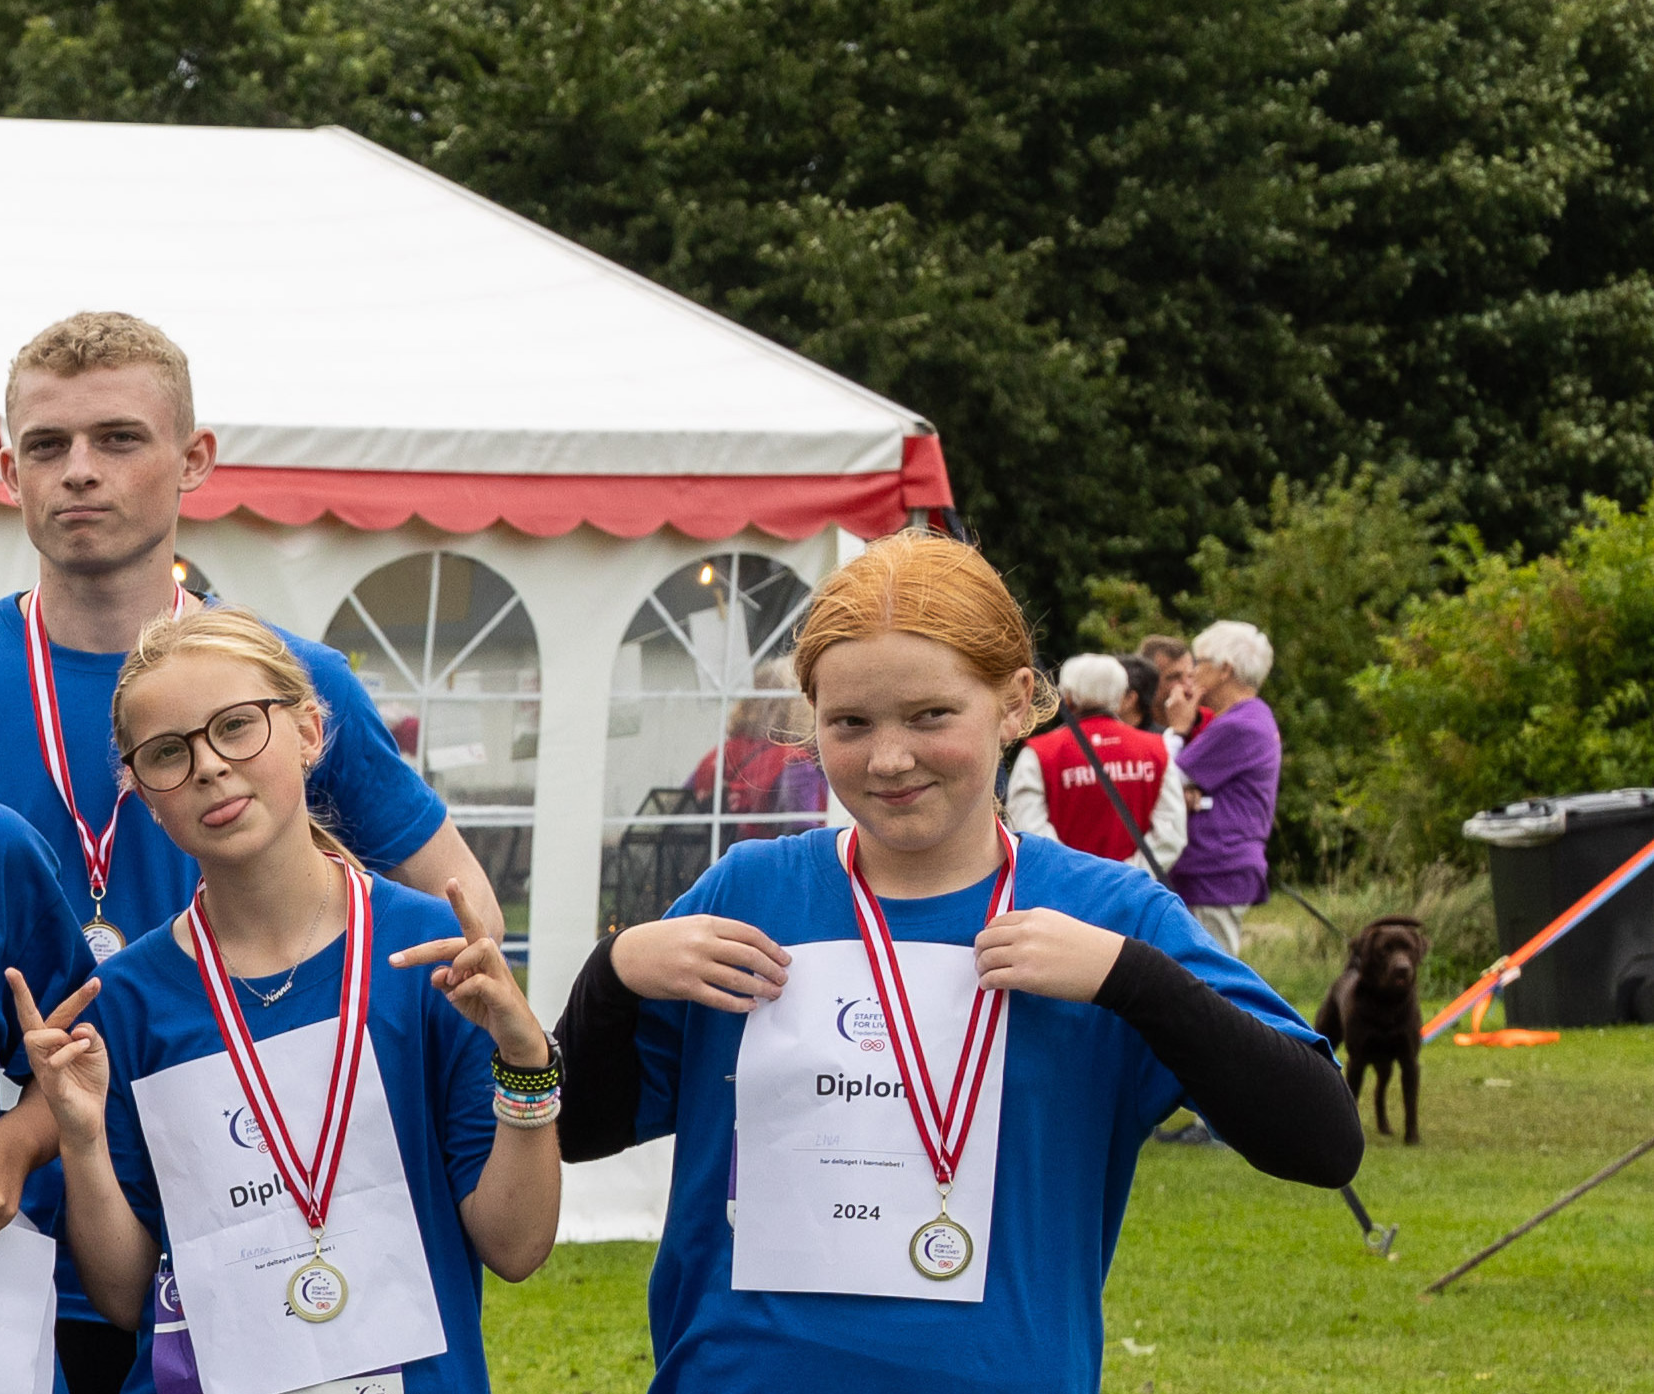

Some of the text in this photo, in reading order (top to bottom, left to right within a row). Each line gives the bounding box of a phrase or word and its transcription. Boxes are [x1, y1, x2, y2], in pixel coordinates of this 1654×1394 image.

[854, 1013, 883, 1021] STAFET
[872, 1021, 889, 1029] LIV
[244, 1118, 258, 1127] STA
[229, 1173, 292, 1208] Dipl
[833, 1203, 881, 1221] 2024
